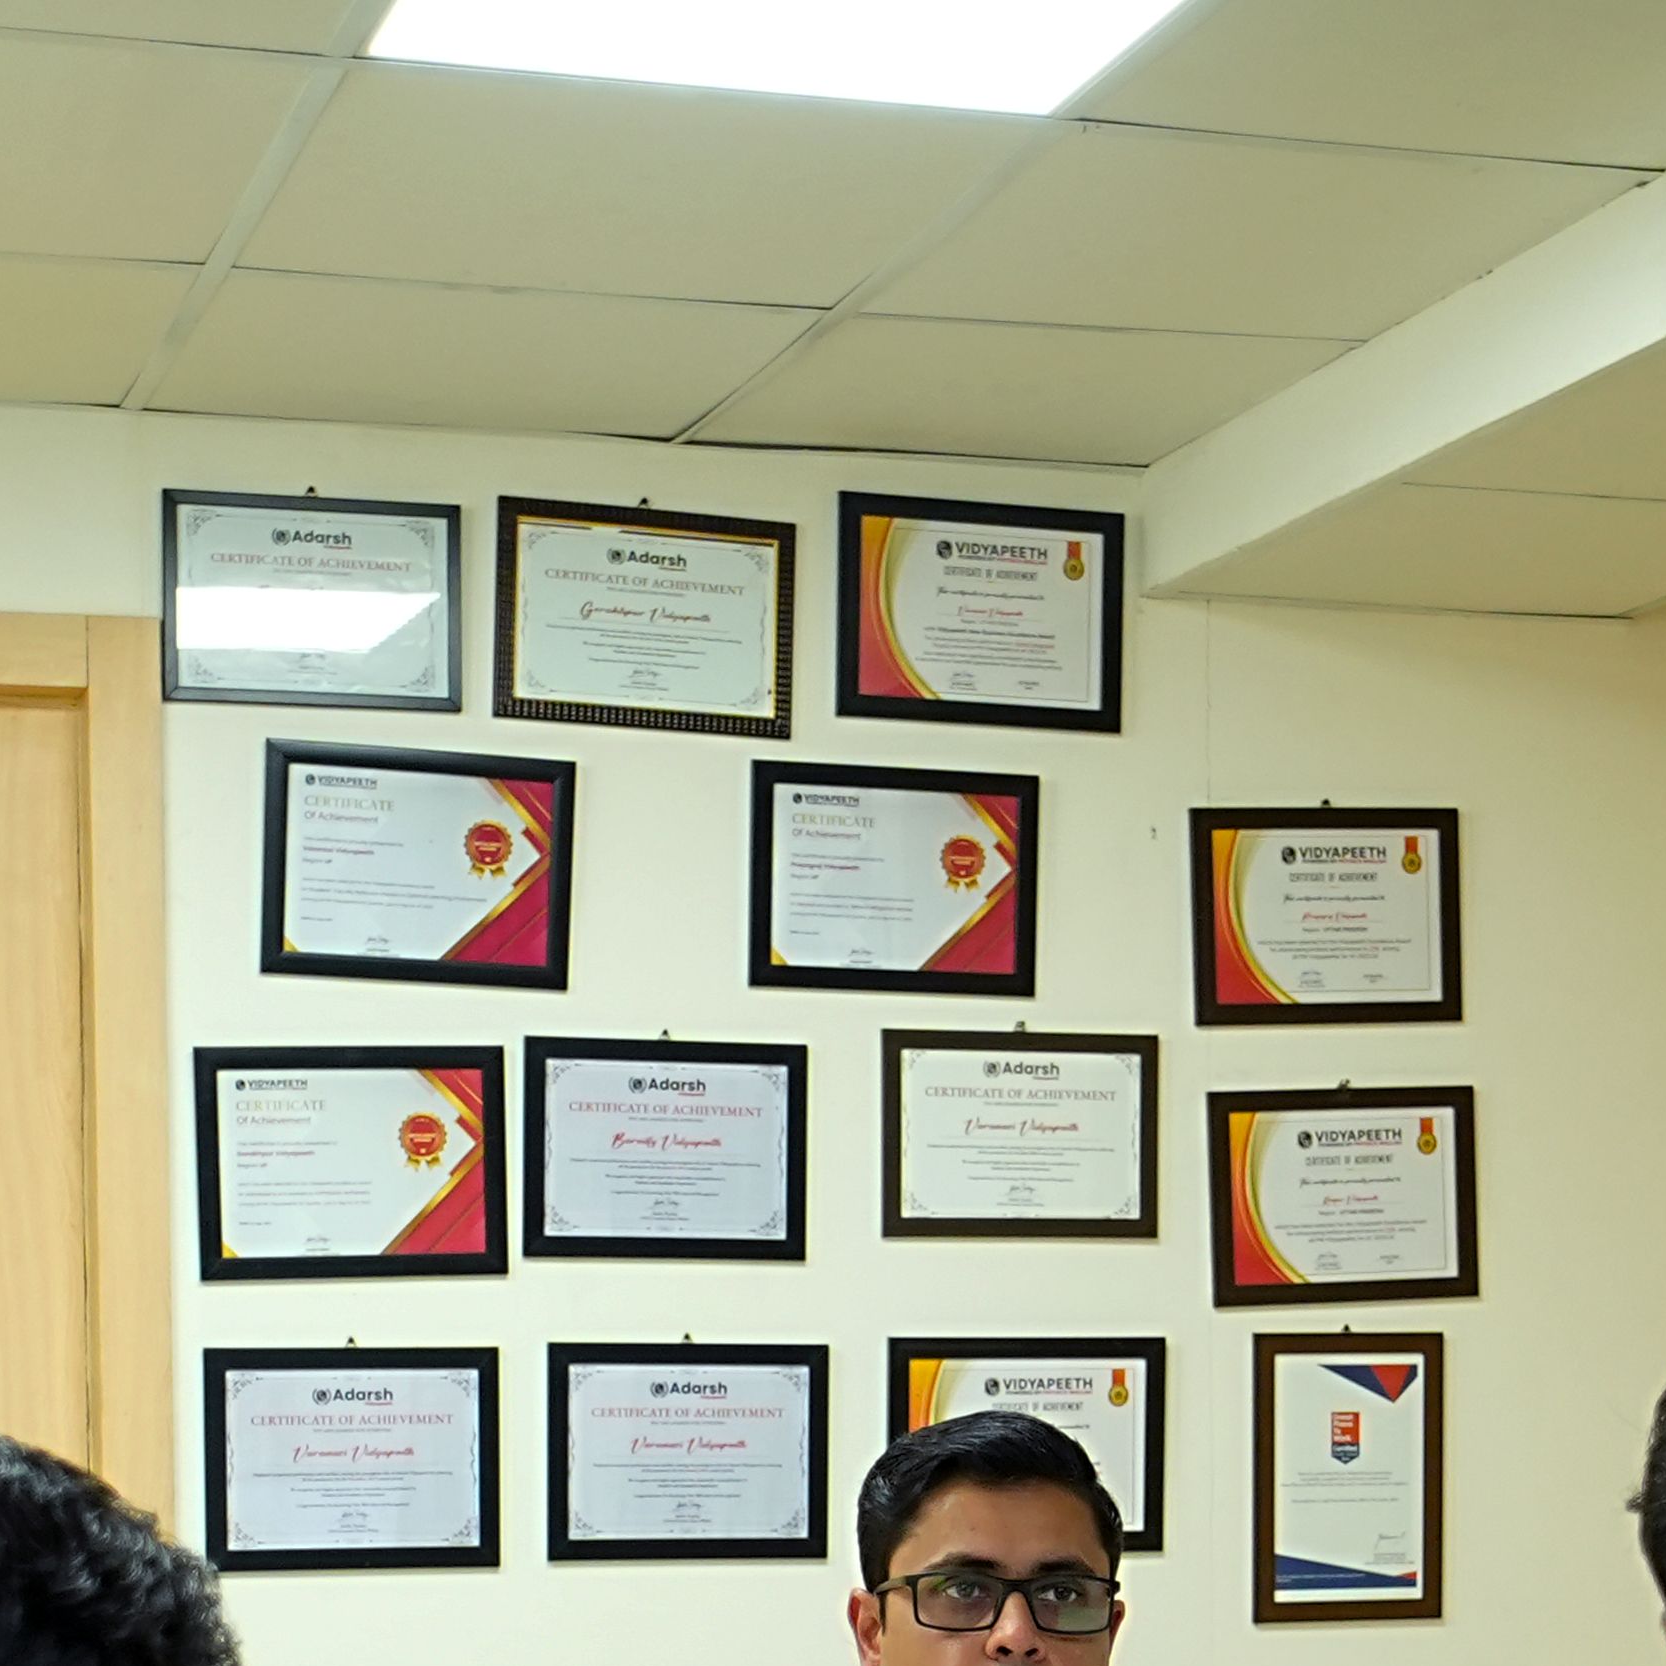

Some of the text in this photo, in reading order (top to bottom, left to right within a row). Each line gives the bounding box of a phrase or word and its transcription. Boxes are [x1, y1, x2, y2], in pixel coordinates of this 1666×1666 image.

[292, 529, 352, 545] Adarsh
[955, 541, 1047, 560] VIDYAPEETH
[211, 553, 411, 572] CERTIFICATE OF ACHIEVEMENT
[627, 551, 687, 568] Adarsh
[545, 569, 744, 596] CERTIFICATE OF ACHIEVEMENT
[304, 795, 394, 811] CERTIFICATE
[792, 813, 875, 828] CERTIFICATE
[1298, 846, 1386, 859] VIDYAPEETH
[1002, 1062, 1060, 1076] Adarsh
[247, 1079, 308, 1088] VIDYAPEETH
[648, 1078, 706, 1092] Adarsh
[925, 1086, 1117, 1101] CERTIFICATE OF ACHIEVEMENT
[236, 1100, 326, 1111] CERTIFICATE
[569, 1101, 763, 1118] CERTIFICATE OF ACHIEVEMENT
[1315, 1128, 1402, 1142] VIDYAPEETH
[670, 1382, 727, 1395] Adarsh
[1003, 1377, 1093, 1390] VIDYAPEETH
[333, 1388, 393, 1401] Adarsh
[250, 1413, 454, 1426] CERTIFICATE OF ACHIEVEMENT
[591, 1407, 785, 1418] CERTIFICATE OF ACHIEVEMENT
